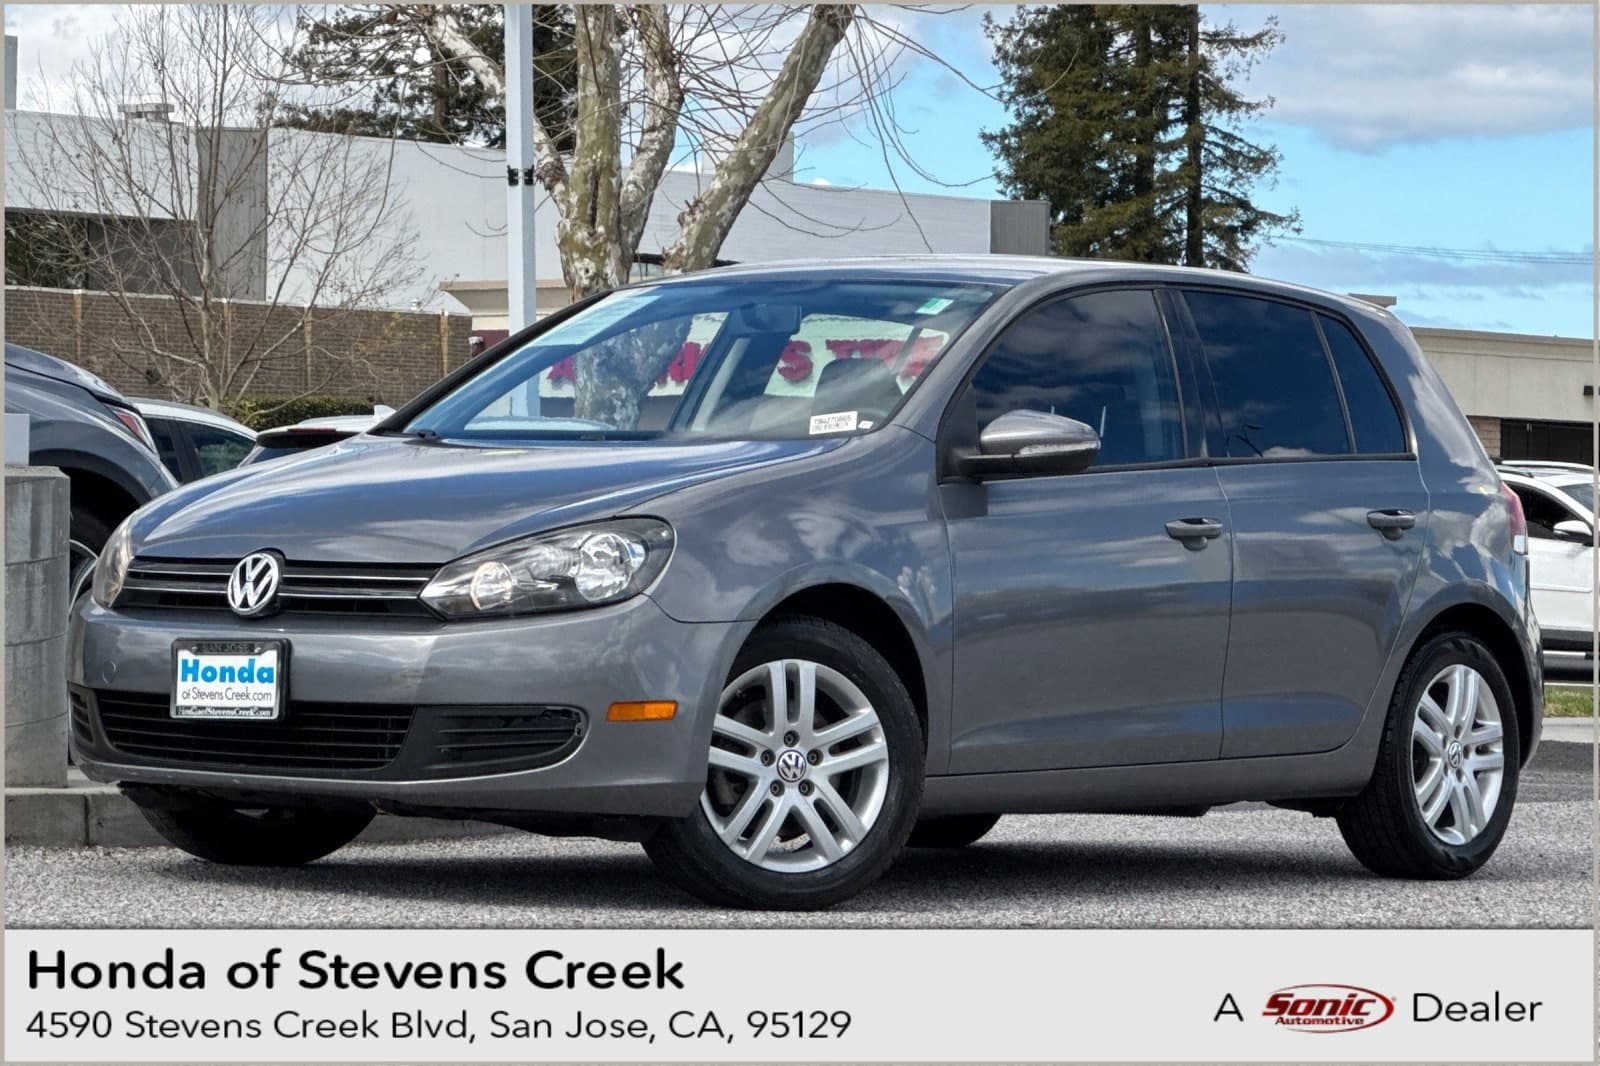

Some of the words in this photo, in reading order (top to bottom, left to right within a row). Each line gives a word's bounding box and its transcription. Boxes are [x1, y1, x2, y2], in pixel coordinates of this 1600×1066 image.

[181, 658, 274, 684] Honda
[182, 688, 192, 701] of
[192, 687, 224, 701] Stevens
[225, 686, 272, 702] Creek.com
